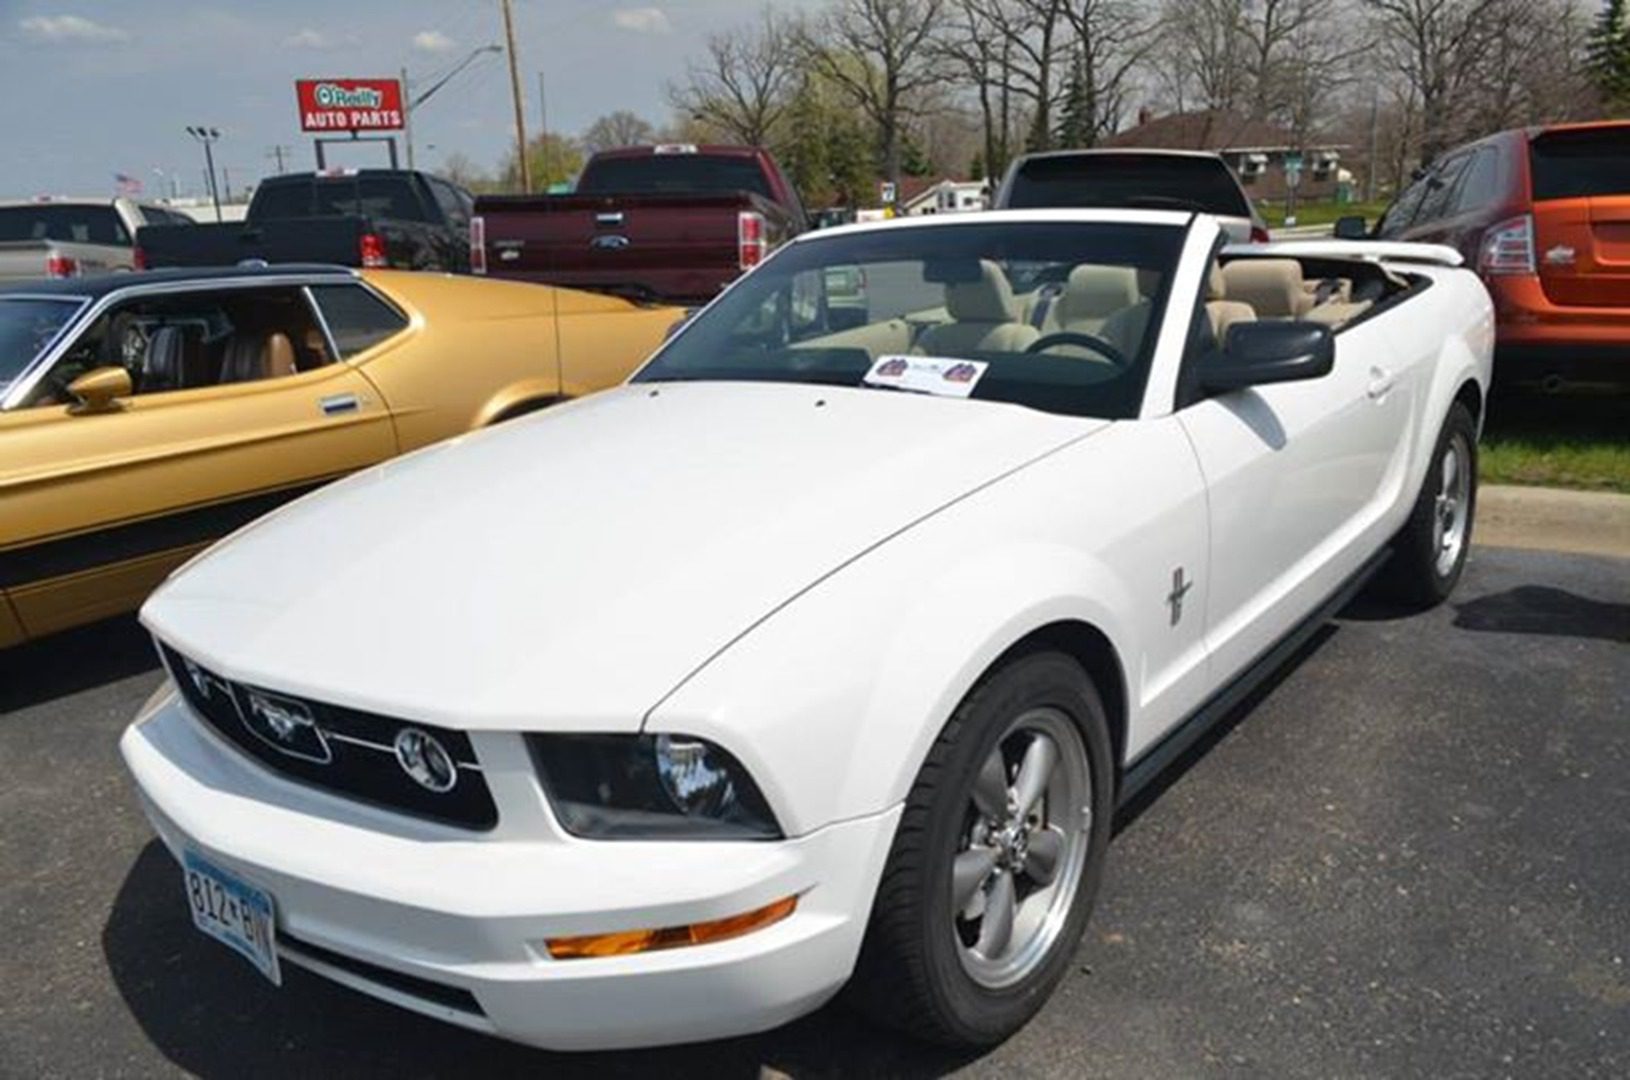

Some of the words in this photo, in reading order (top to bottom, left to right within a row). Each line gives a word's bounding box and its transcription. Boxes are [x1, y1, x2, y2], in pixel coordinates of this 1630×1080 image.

[315, 84, 381, 107] O'Reilly
[305, 111, 347, 127] AUTO
[350, 110, 401, 126] PARTS
